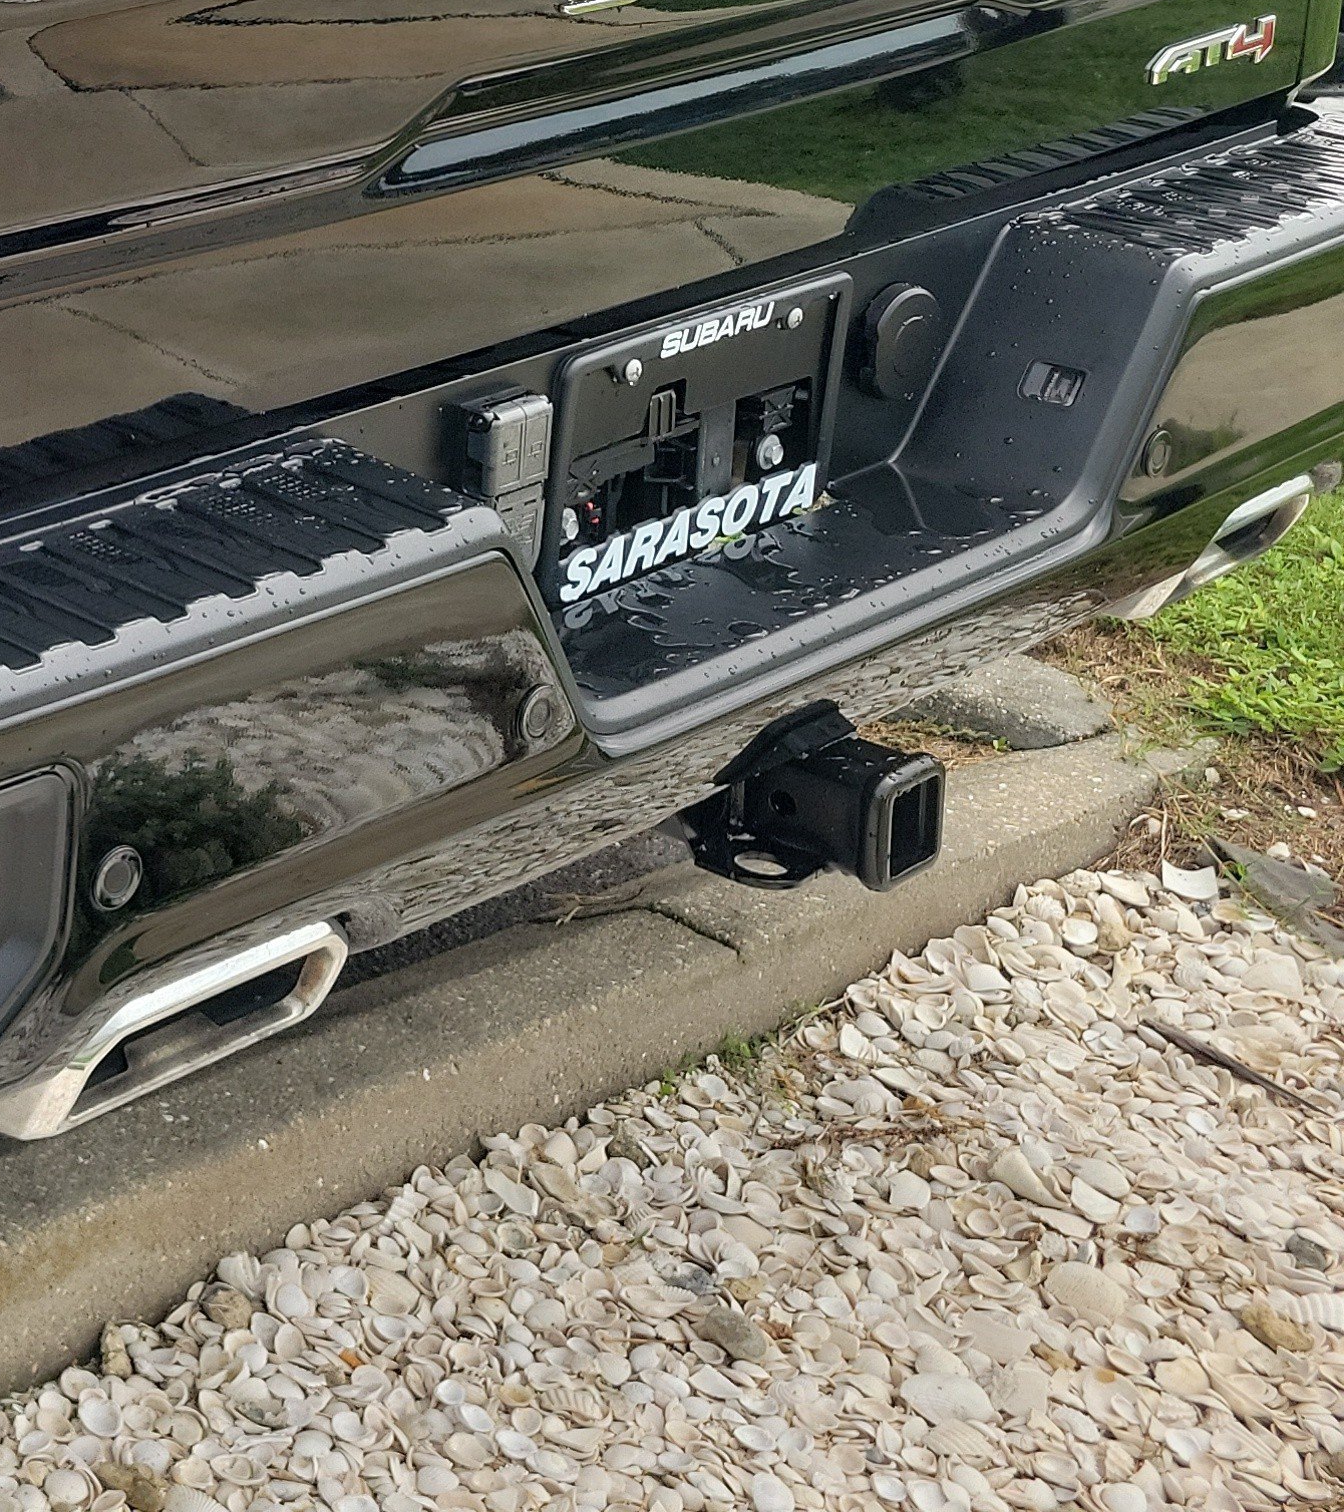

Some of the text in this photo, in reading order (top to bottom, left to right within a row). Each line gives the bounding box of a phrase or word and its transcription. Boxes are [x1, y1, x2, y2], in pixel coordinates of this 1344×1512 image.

[1145, 14, 1278, 86] AT4
[660, 301, 775, 359] SUBARU
[560, 461, 818, 603] SARASOTA
